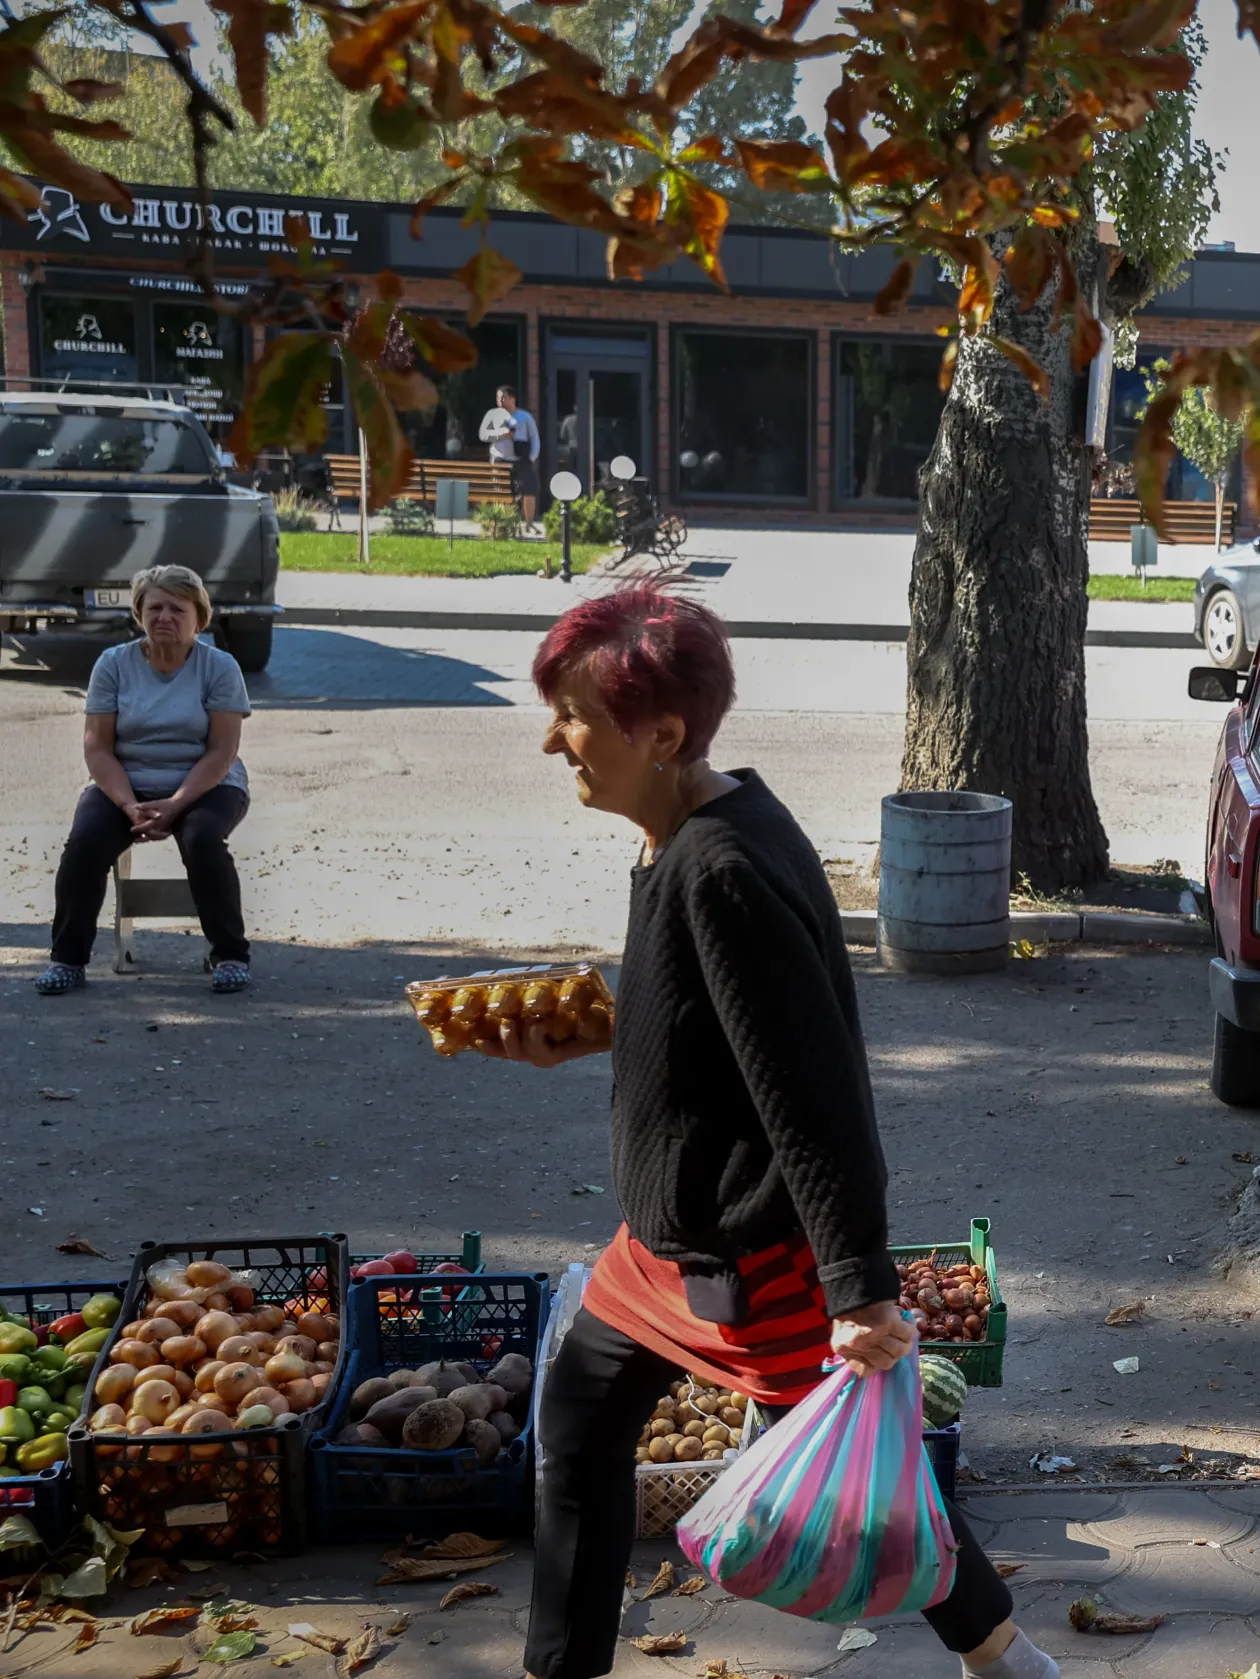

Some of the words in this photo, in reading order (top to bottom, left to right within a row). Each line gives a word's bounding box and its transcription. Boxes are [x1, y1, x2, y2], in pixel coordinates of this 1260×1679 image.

[99, 198, 359, 242] CHURCHLL
[213, 283, 250, 296] STOR
[53, 339, 127, 355] CHURCHILL
[175, 347, 224, 360] МАГАЗИН
